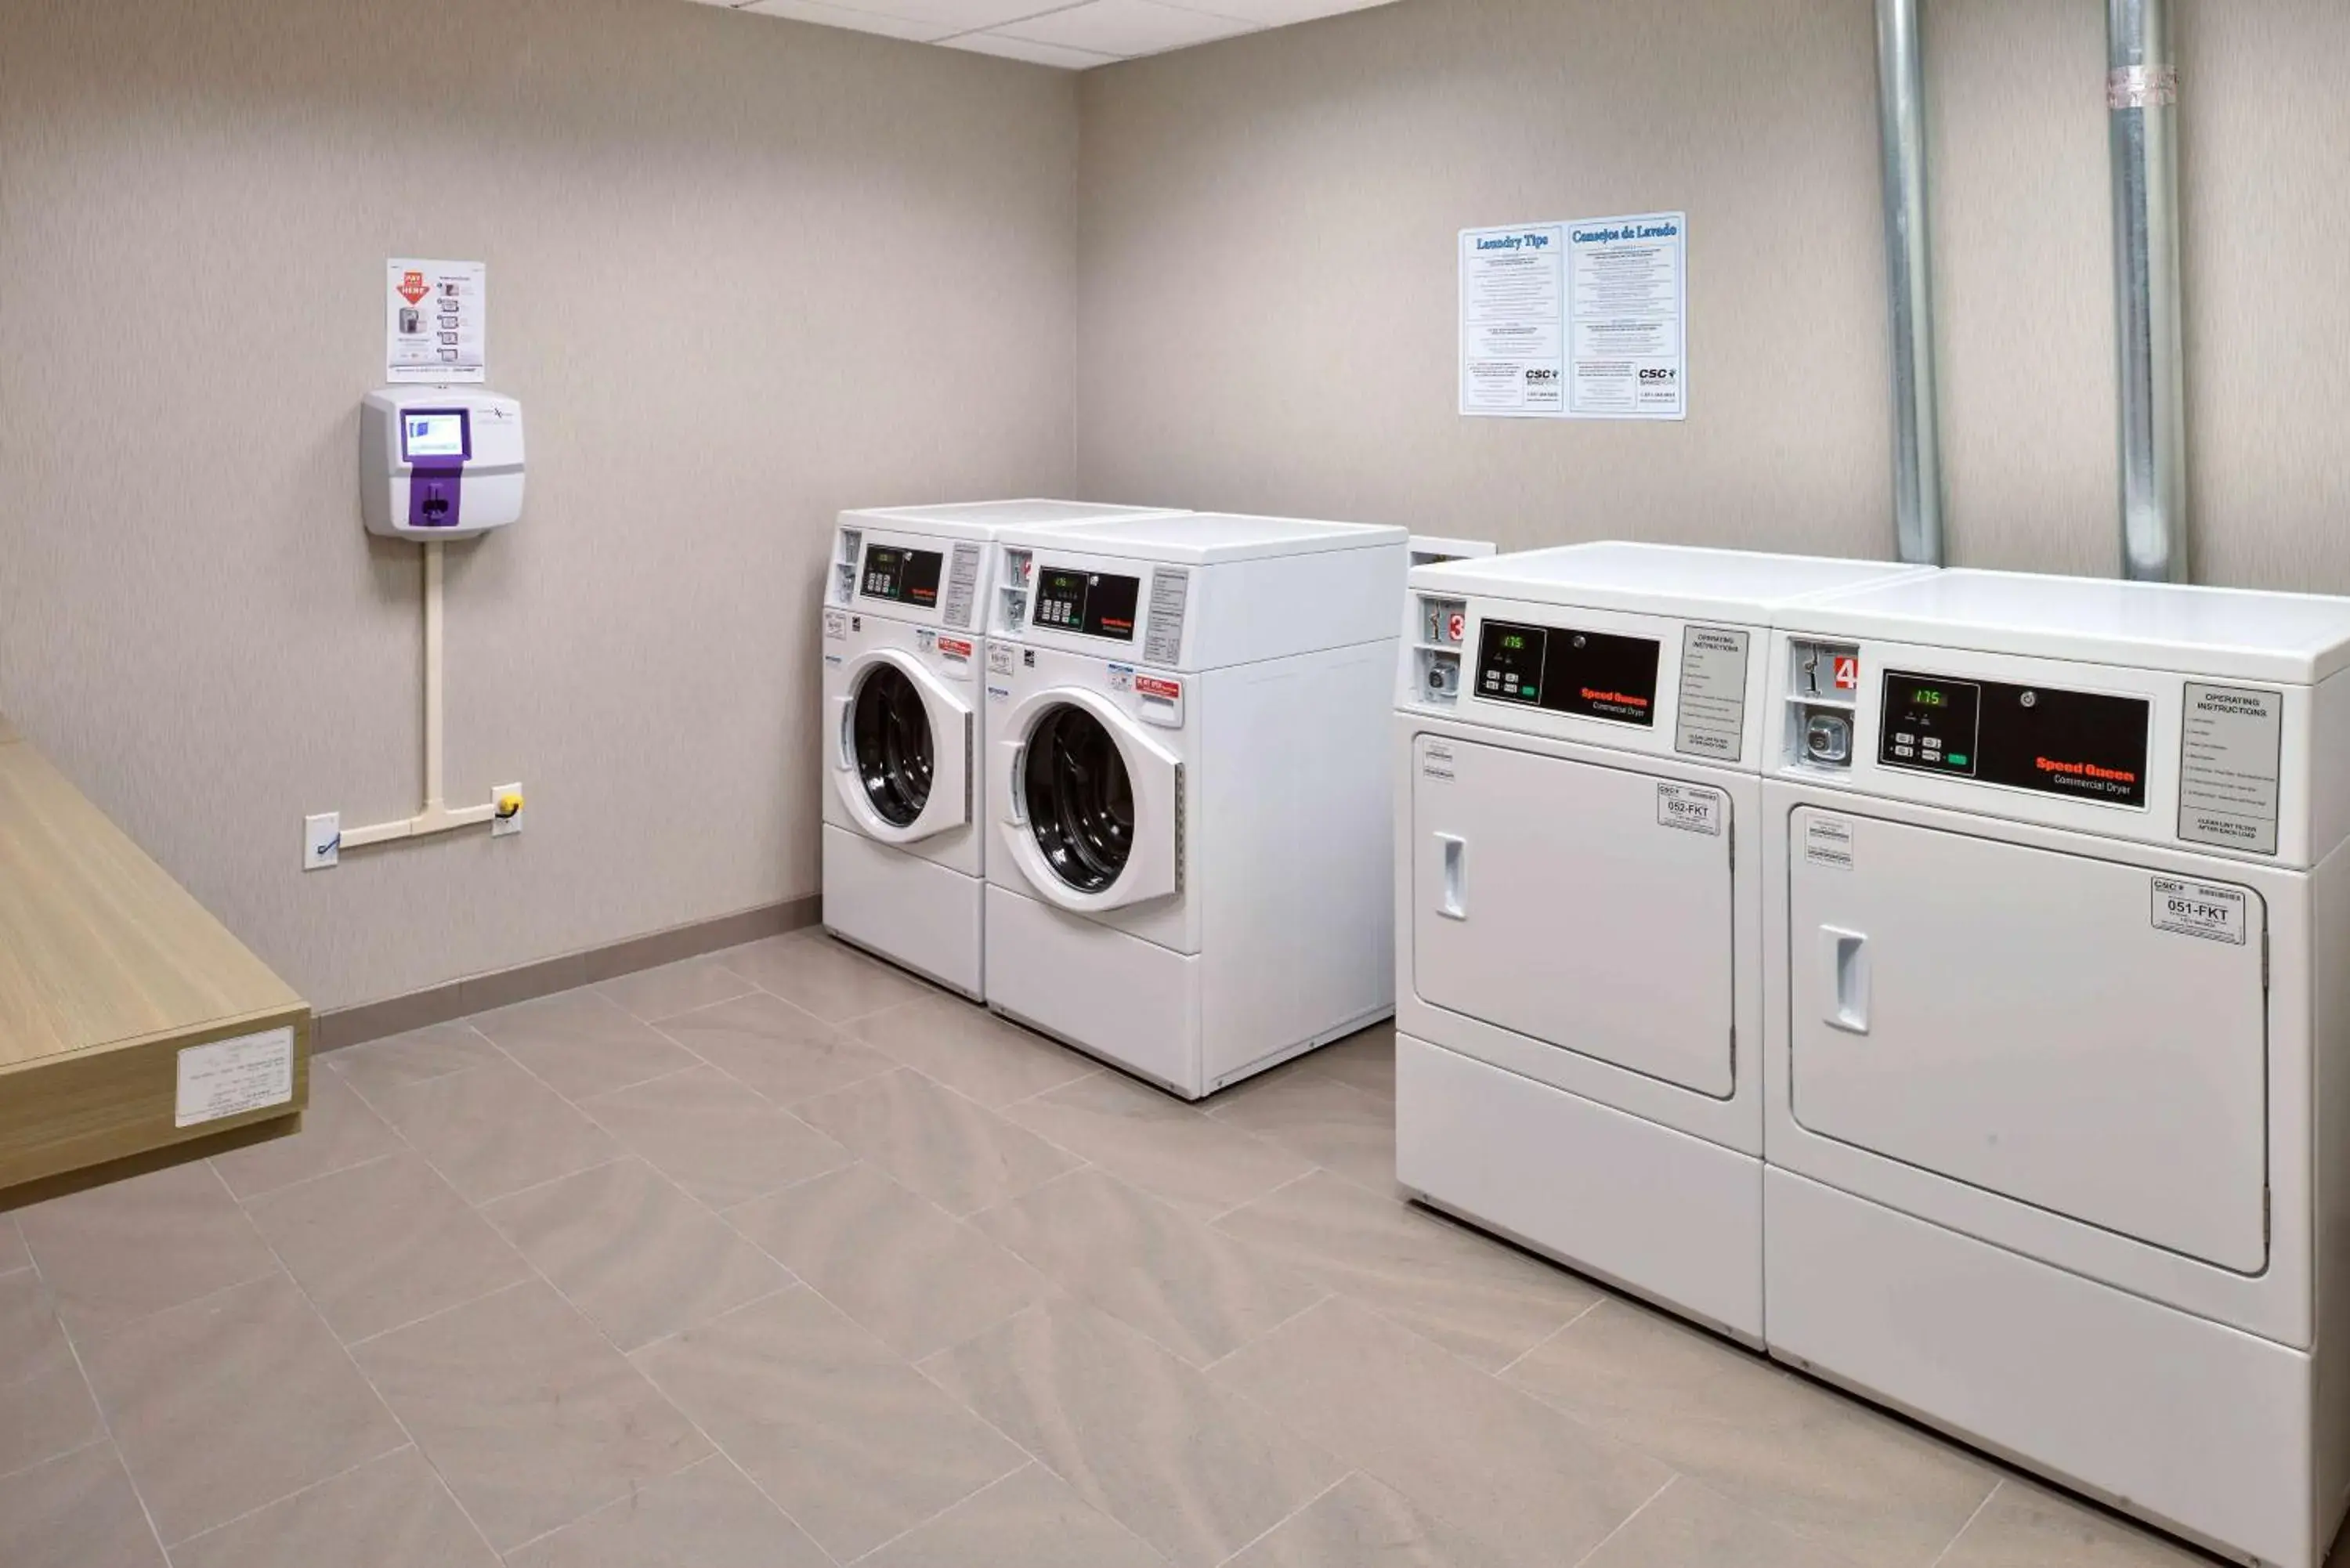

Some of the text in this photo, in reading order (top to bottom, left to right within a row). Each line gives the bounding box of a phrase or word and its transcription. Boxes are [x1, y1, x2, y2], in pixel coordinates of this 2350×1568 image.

[1572, 222, 1677, 244] Consejos de Lavado
[1477, 234, 1549, 250] Laundry Tips
[1526, 369, 1551, 379] CSC
[1639, 369, 1668, 378] CSC
[1451, 615, 1465, 641] 3
[1836, 659, 1856, 688] 4
[1582, 687, 1613, 701] Speed
[2205, 692, 2261, 707] OPERATING
[2197, 702, 2267, 717] INSTRUCTIONS
[2036, 757, 2135, 783] Speed Queen
[2054, 774, 2131, 795] Commercial Dryer
[1668, 800, 1708, 817] 052-FKT
[2167, 899, 2229, 920] 051-FKT
